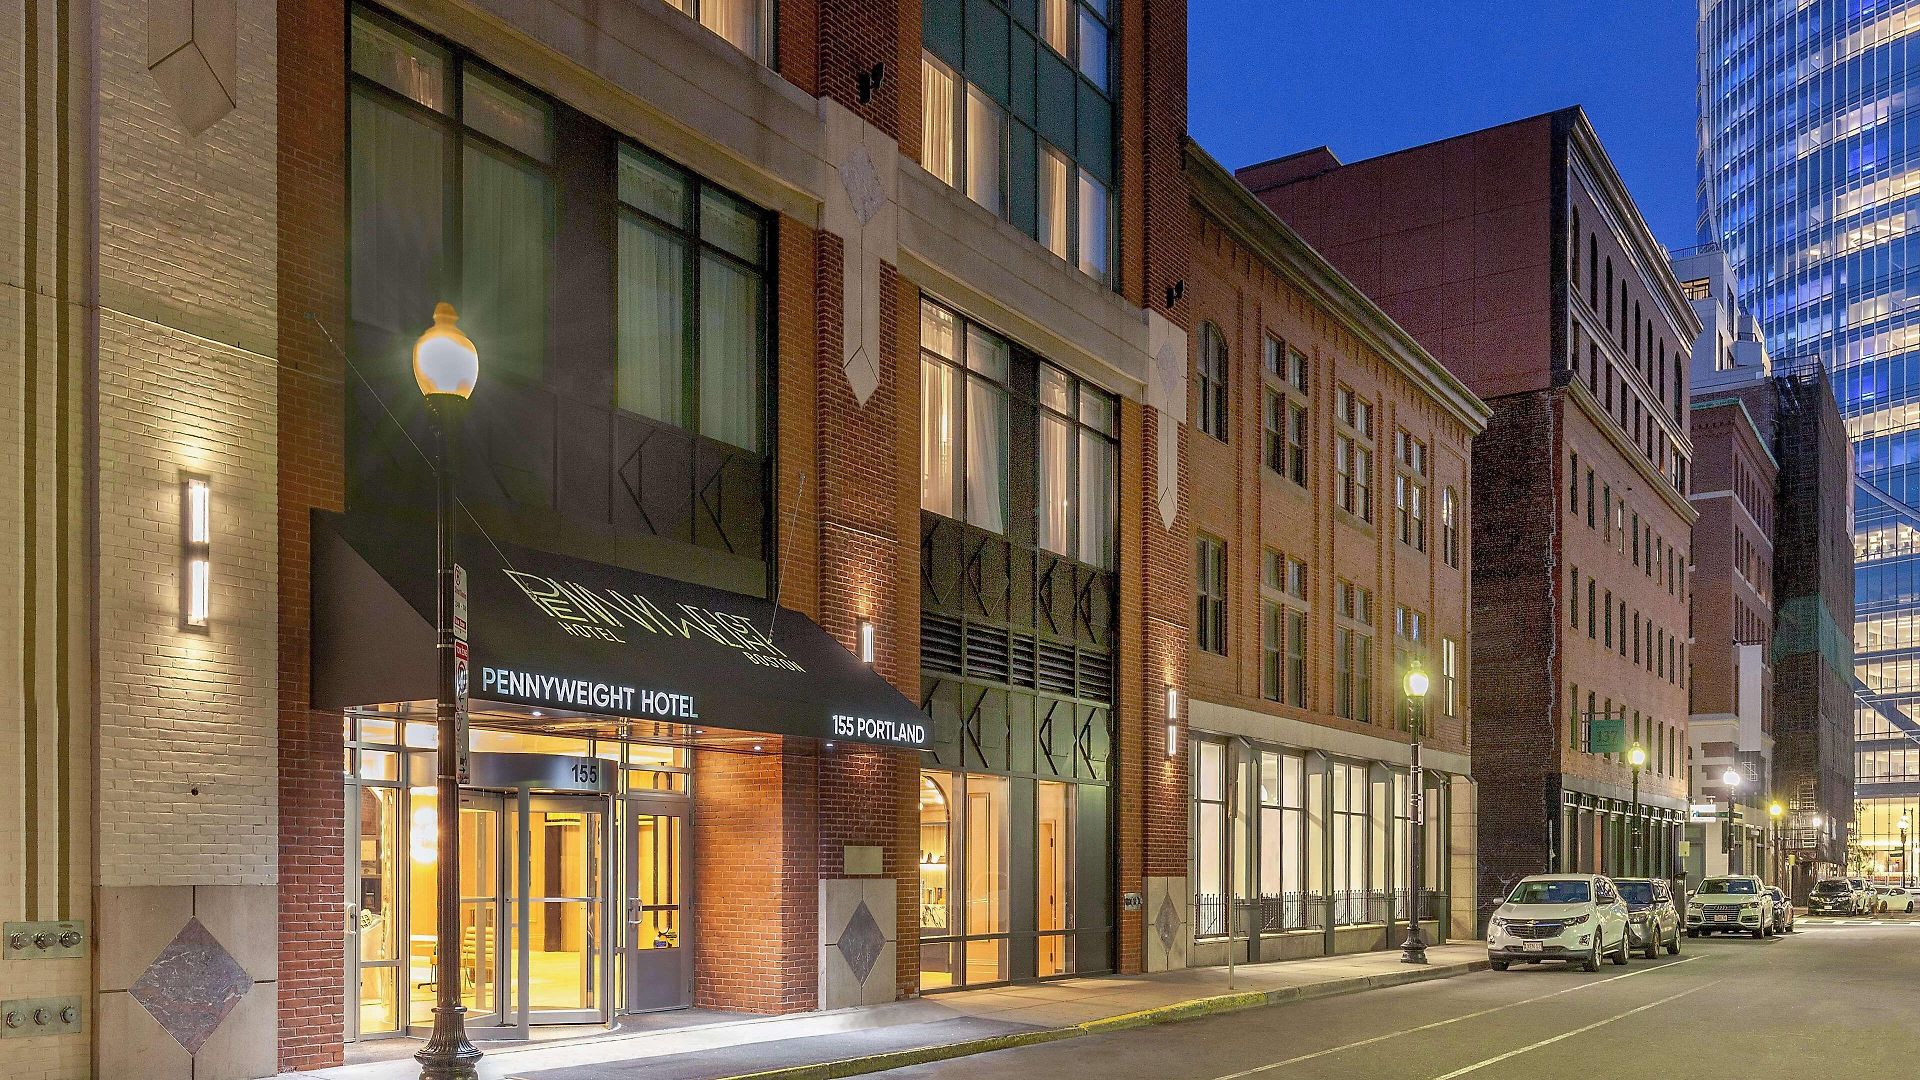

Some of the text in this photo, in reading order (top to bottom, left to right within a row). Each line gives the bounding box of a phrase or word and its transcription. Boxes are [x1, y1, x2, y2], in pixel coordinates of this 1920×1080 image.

[557, 621, 627, 643] HOTEL
[742, 651, 807, 673] BOSTON
[482, 666, 699, 719] PENNYWEIGHT HOTEL
[832, 714, 925, 744] 155 PORTLAND
[571, 764, 597, 783] 155
